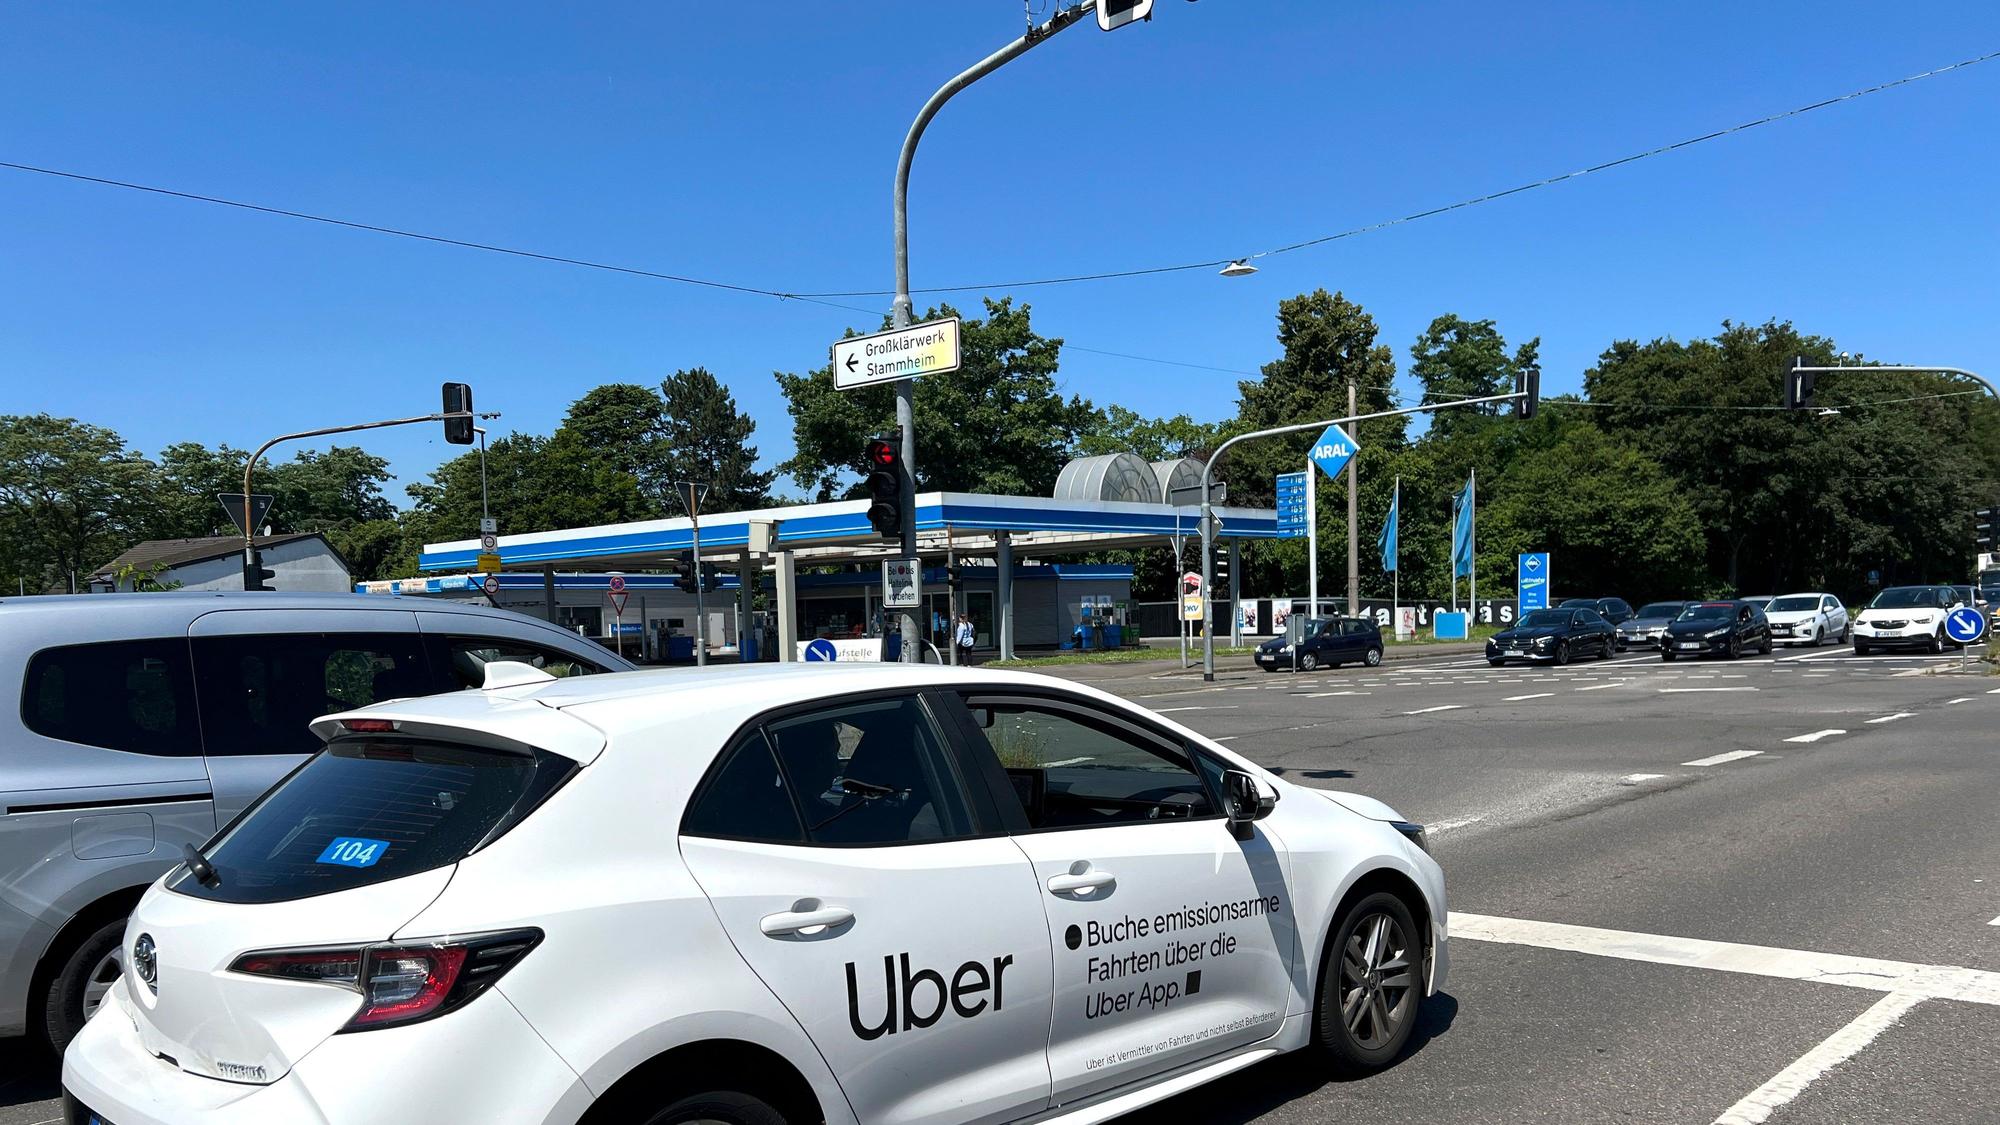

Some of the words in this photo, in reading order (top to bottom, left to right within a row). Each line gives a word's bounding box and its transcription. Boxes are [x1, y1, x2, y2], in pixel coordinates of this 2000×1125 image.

[865, 330, 945, 357] Großklärwerk
[867, 354, 935, 377] Stammheim
[1314, 443, 1350, 460] ARAL
[331, 840, 378, 864] 104
[1087, 915, 1149, 947] Buche
[1154, 895, 1280, 932] emissionsarme
[1088, 951, 1160, 984] Fahrten
[1165, 941, 1206, 967] über
[1210, 932, 1236, 957] die
[844, 952, 1014, 1041] Uber
[1085, 992, 1135, 1020] Uber
[1137, 980, 1181, 1010] App.
[1086, 1057, 1105, 1070] Uber
[1106, 1054, 1116, 1065] ist
[1117, 1044, 1154, 1061] Vermittler
[1155, 1040, 1168, 1051] von
[1168, 1033, 1195, 1047] Fahrten
[1196, 1029, 1209, 1040] und
[1210, 1024, 1226, 1035] nicht
[1226, 1018, 1245, 1032] selbst
